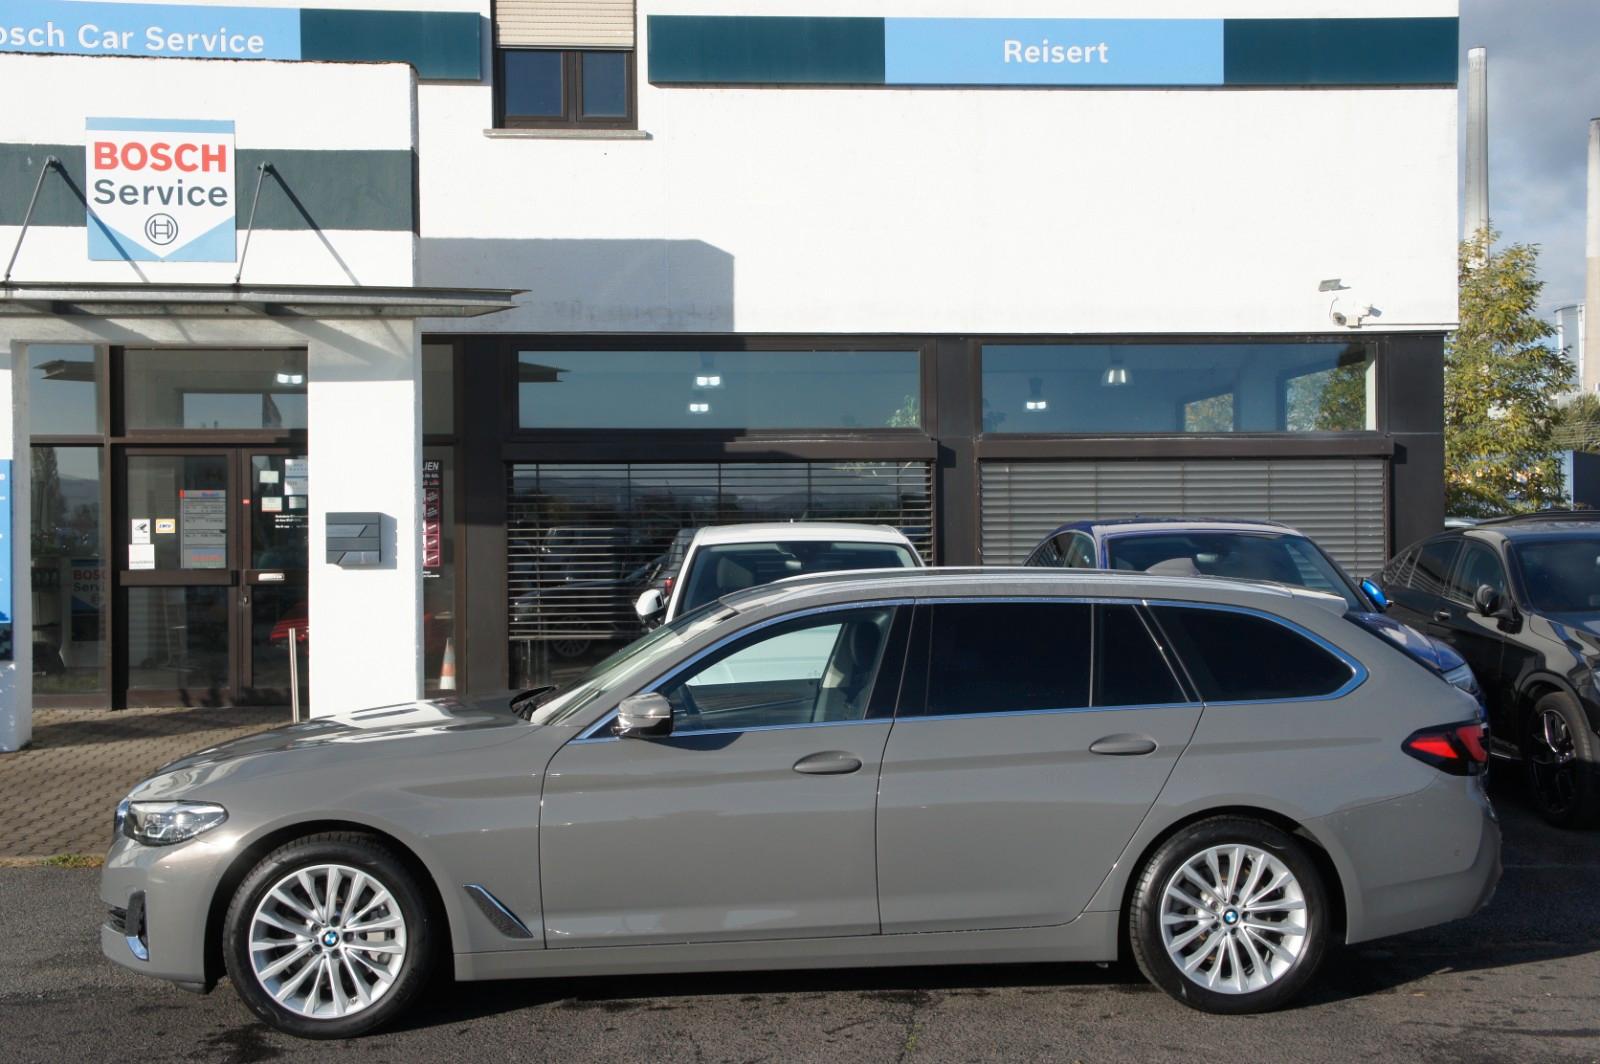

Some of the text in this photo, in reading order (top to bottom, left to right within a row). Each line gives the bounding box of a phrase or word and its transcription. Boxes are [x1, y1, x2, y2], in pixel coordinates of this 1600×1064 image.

[78, 24, 134, 50] Car
[145, 27, 265, 53] Service
[1003, 39, 1109, 63] Reisert
[94, 142, 227, 173] BOSCH
[93, 178, 228, 207] Service
[73, 569, 106, 580] BOS
